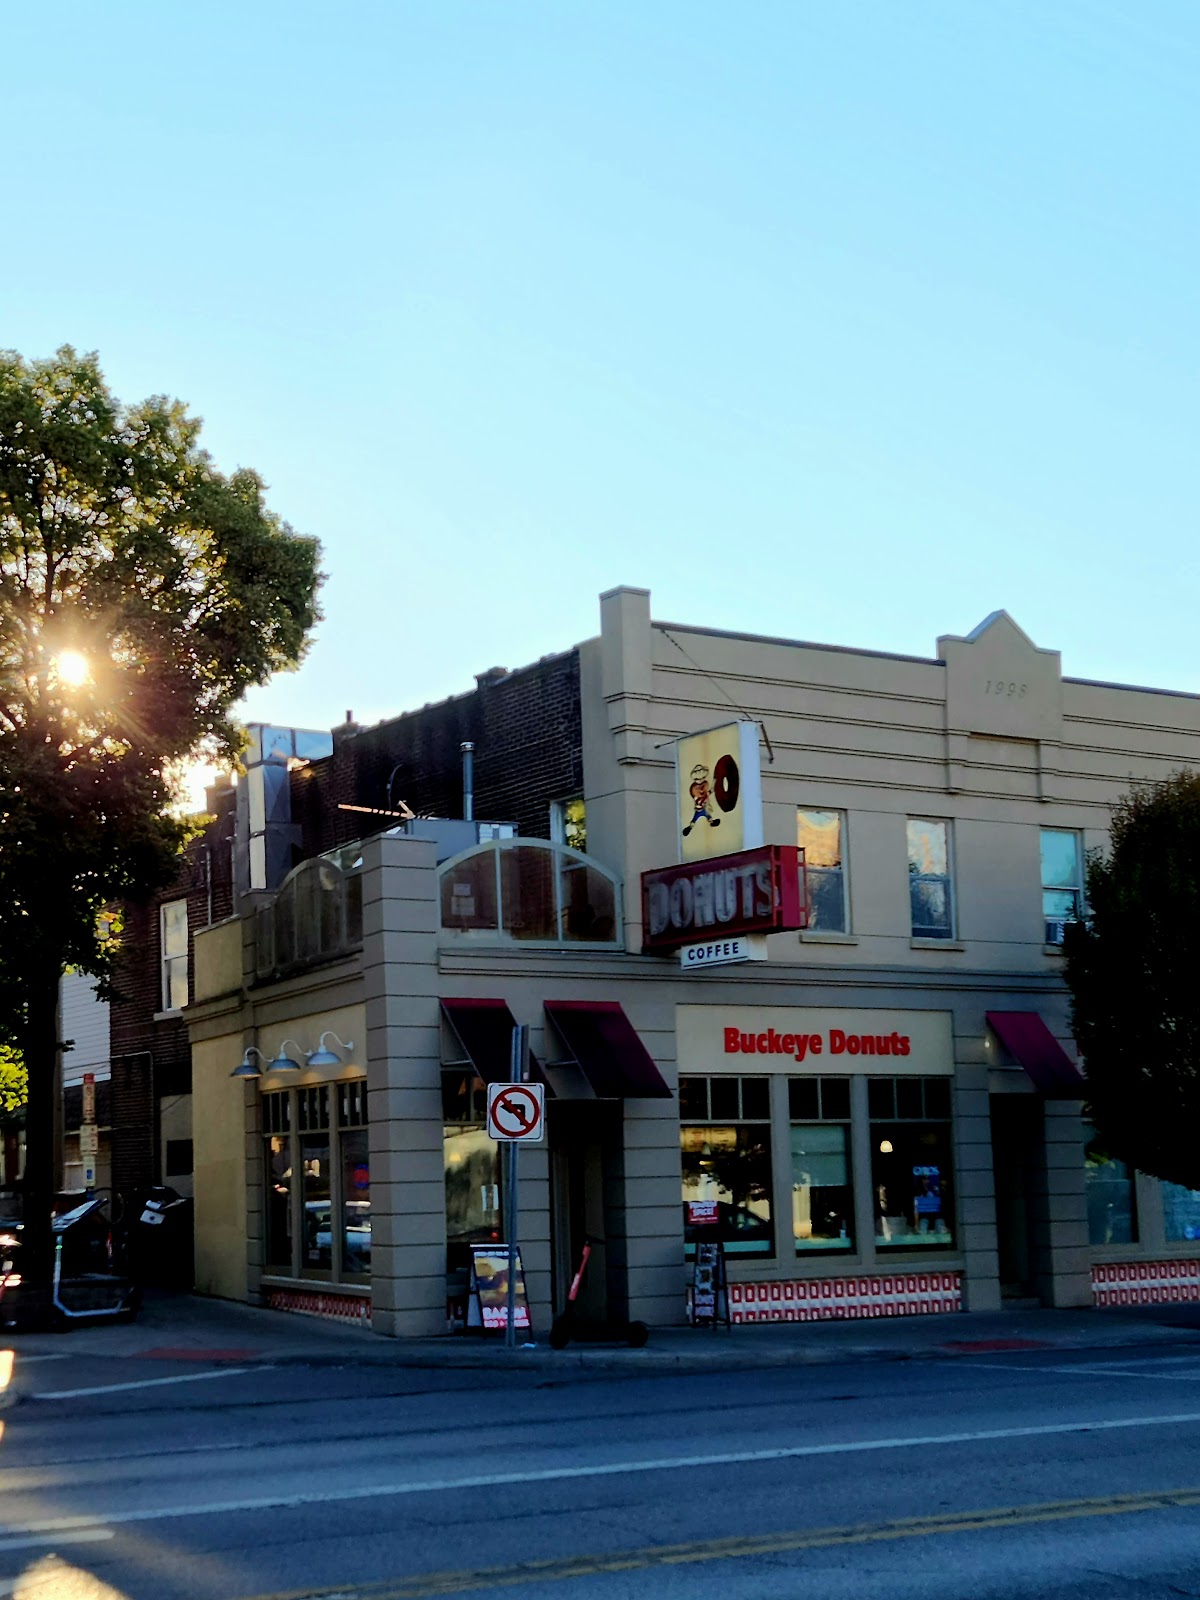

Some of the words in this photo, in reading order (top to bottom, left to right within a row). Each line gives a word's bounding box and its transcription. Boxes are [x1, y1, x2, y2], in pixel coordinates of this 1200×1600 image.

[648, 861, 780, 936] DONUTS
[688, 942, 739, 961] COFFEE
[724, 1027, 822, 1062] Buckeye
[829, 1029, 911, 1056] Donuts
